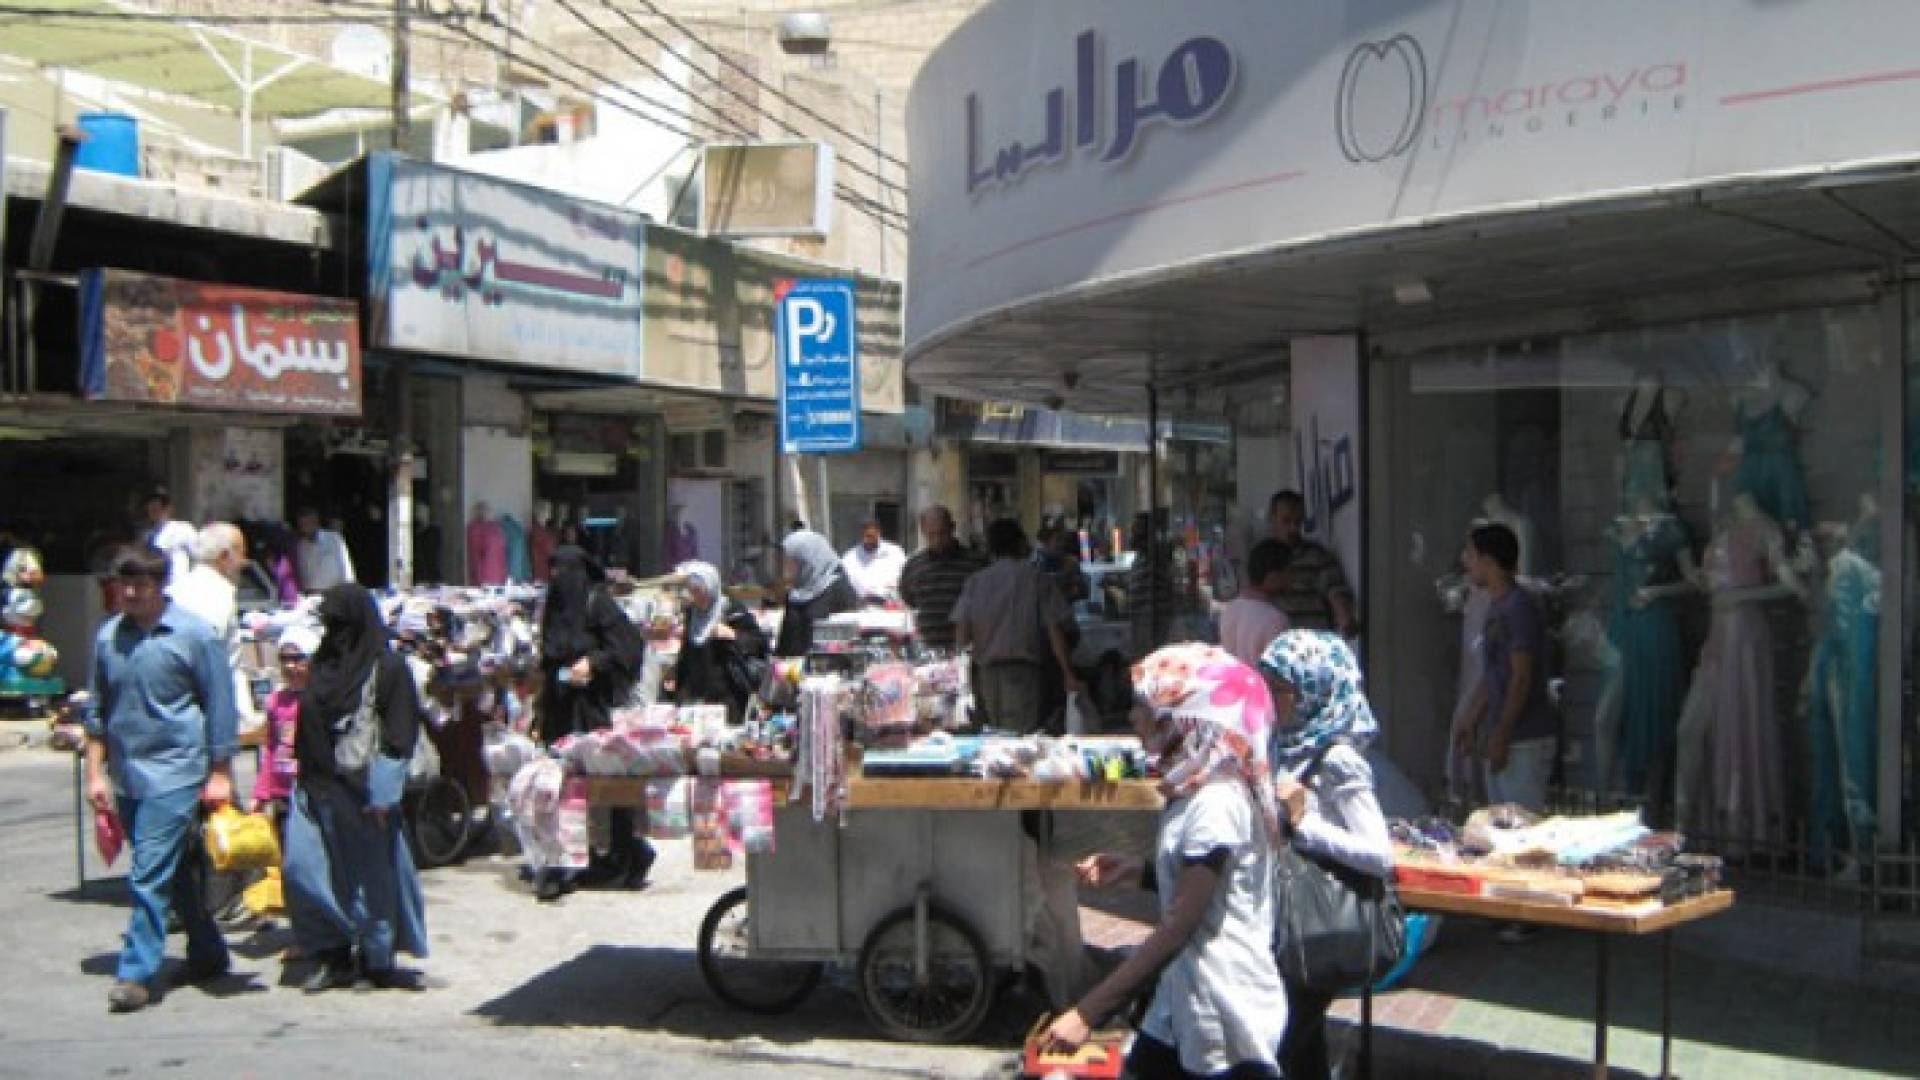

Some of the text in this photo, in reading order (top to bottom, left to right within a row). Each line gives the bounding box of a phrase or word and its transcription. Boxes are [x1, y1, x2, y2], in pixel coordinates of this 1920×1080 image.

[966, 29, 1232, 194] مرايا
[1432, 60, 1687, 127] maraya
[1433, 94, 1686, 149] LINGERIE
[786, 297, 825, 365] P
